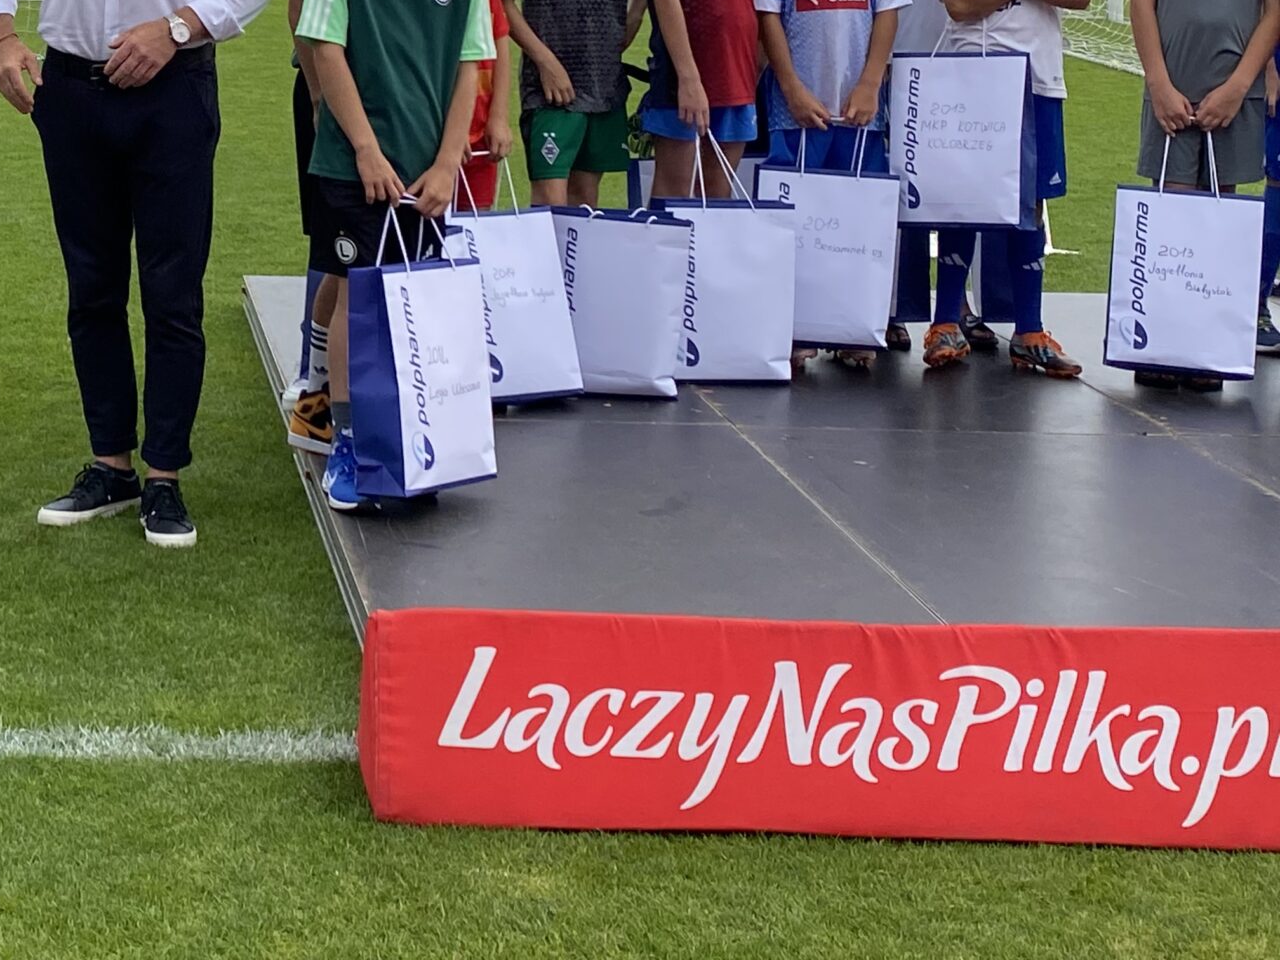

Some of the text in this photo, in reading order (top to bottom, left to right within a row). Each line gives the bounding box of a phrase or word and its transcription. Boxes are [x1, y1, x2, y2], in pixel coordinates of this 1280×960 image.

[903, 67, 921, 176] polpharma
[929, 102, 967, 116] 2013
[802, 215, 840, 231] 2013
[1157, 245, 1195, 258] 2013
[1129, 201, 1150, 316] polpharma
[400, 286, 430, 428] polpharma
